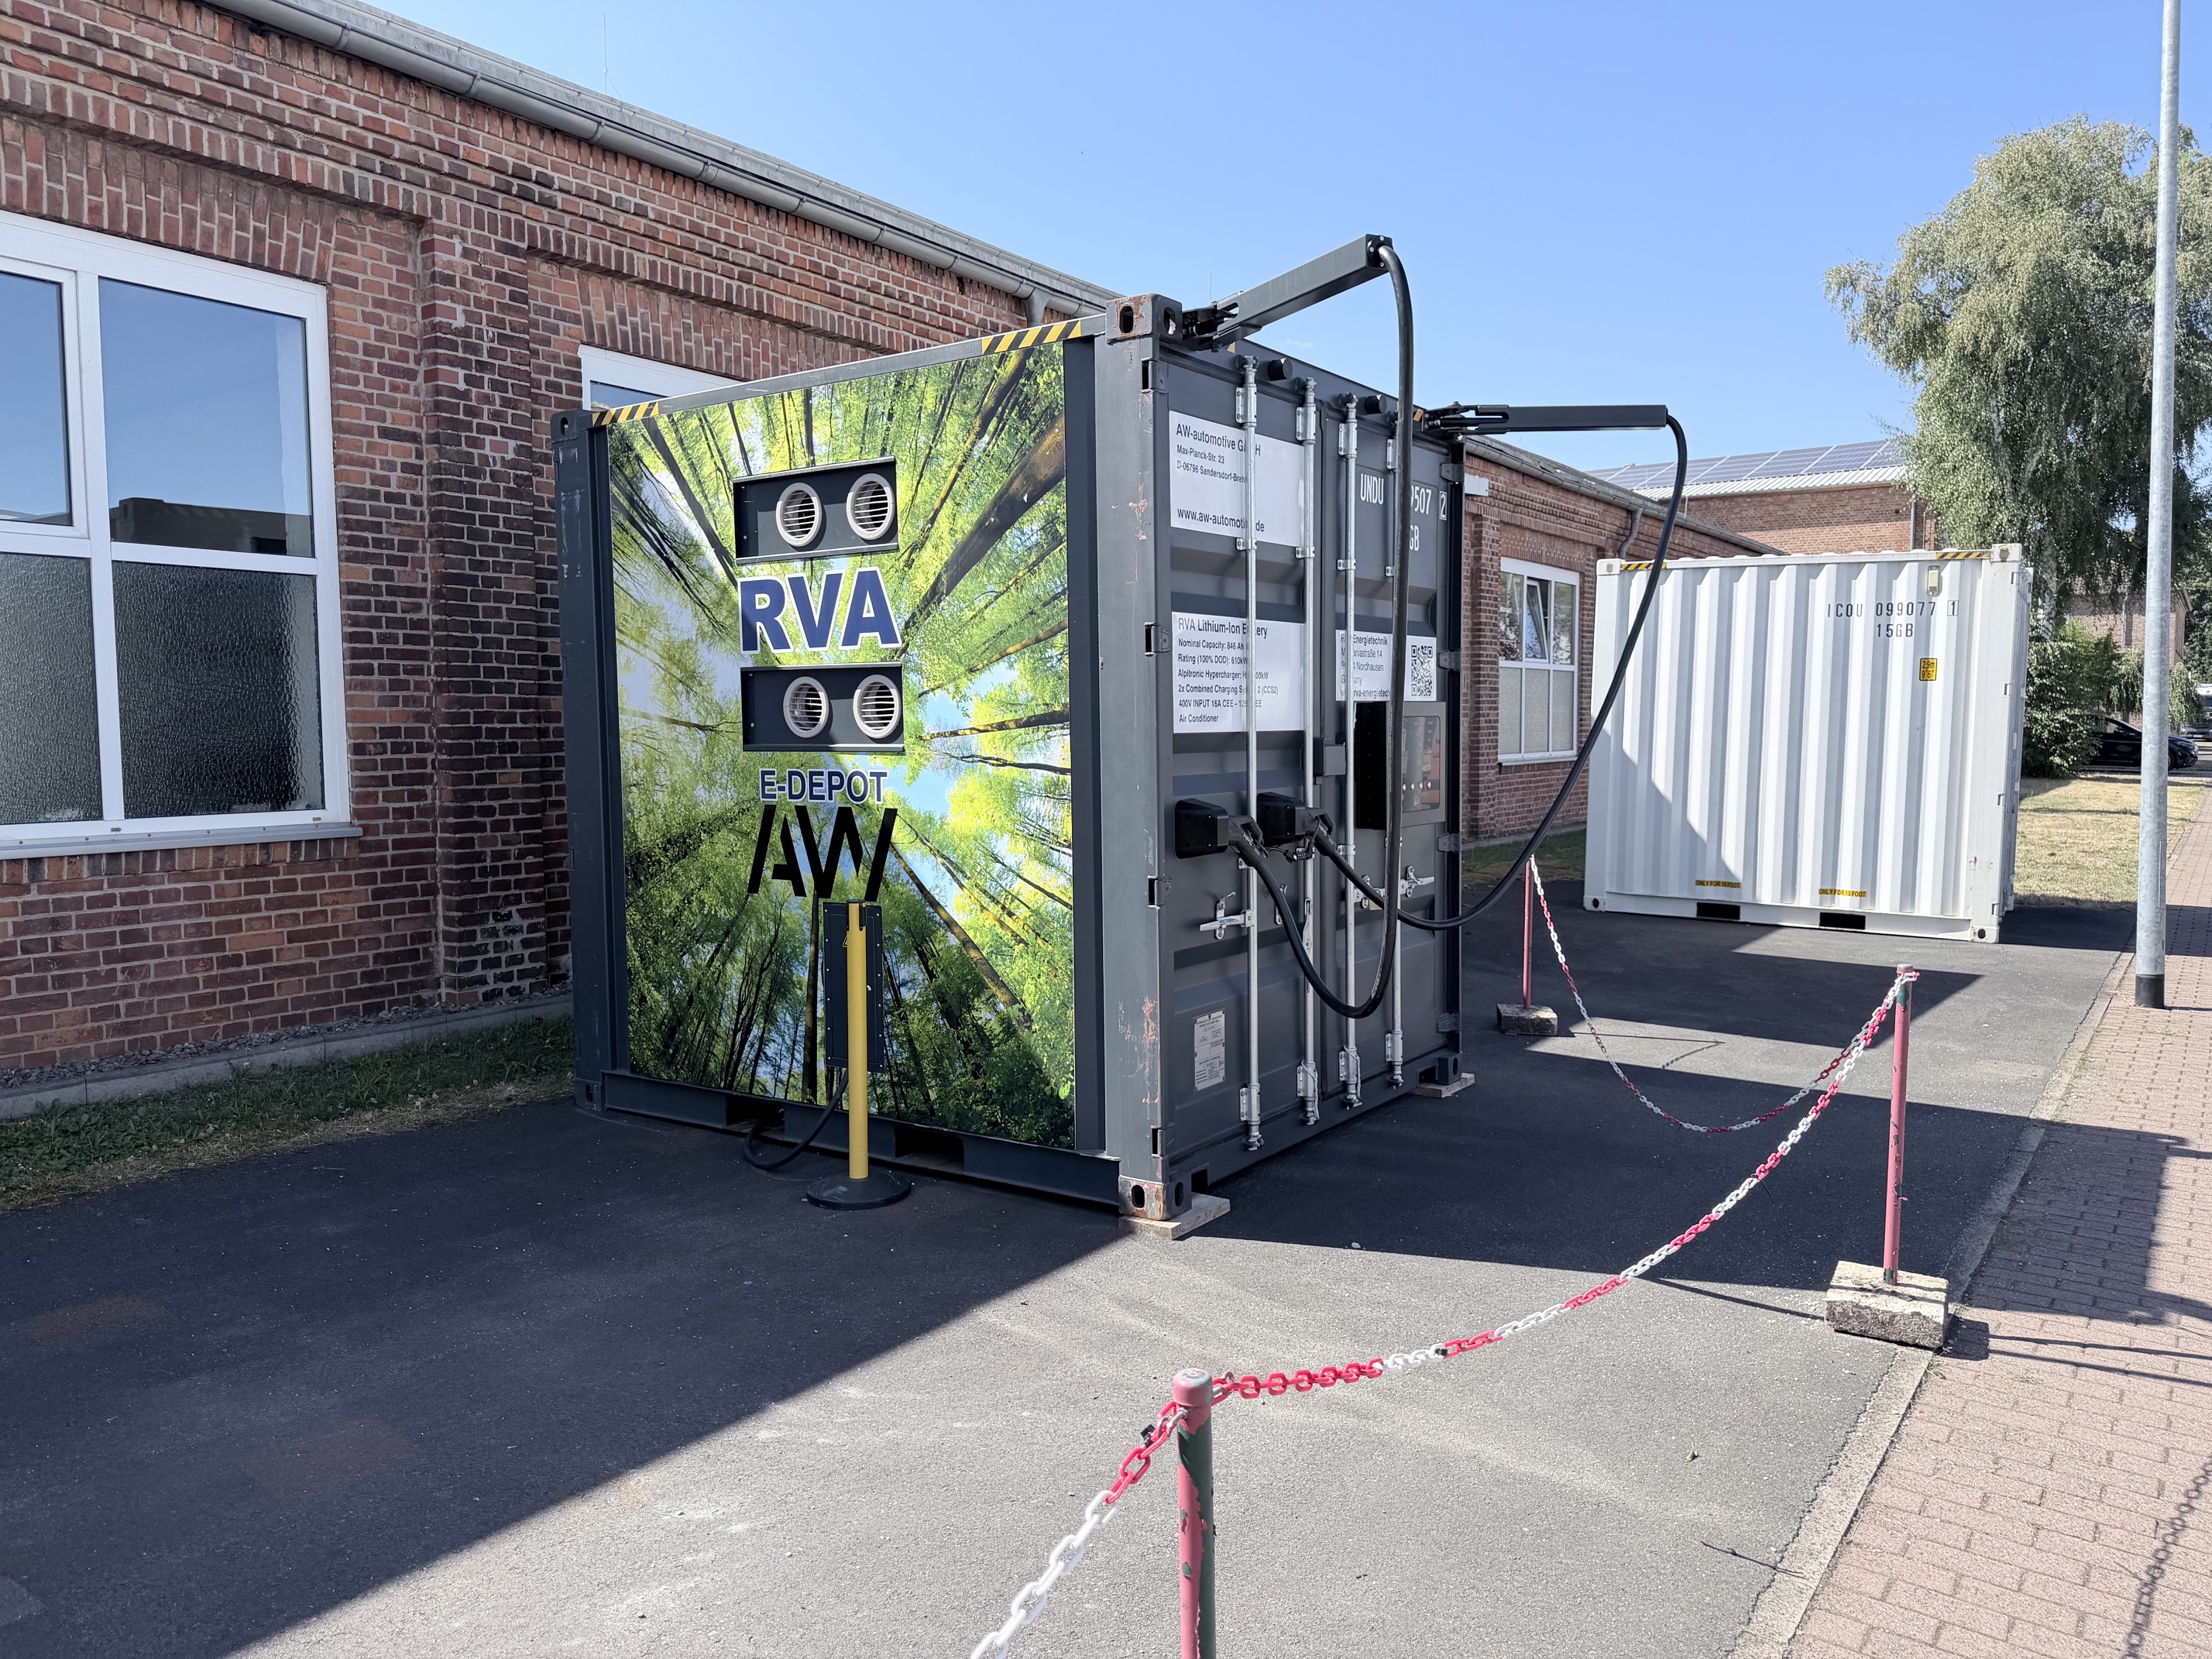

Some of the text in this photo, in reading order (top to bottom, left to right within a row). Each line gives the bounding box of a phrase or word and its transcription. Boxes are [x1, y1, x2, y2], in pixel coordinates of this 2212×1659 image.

[1176, 423, 1261, 456] AW-automotive GH
[1176, 444, 1224, 464] Max-Planck-Str. 23
[1176, 460, 1245, 483] D-06796 Sandersdorf-Breh
[1360, 472, 1384, 505] UNDU
[1440, 493, 1447, 519] 2
[1176, 508, 1265, 532] www.aw-automotide
[737, 565, 902, 654] RVA
[1827, 603, 1863, 618] ICOU
[1876, 601, 1936, 617] 099077
[1178, 617, 1268, 639] RVA Lithium-Ion Bery
[1877, 623, 1913, 637] 15GB
[1178, 638, 1201, 648] Nominal
[1201, 640, 1226, 651] Capacity:
[1227, 641, 1237, 650] 846
[1178, 654, 1196, 665] Rating
[1197, 654, 1214, 665] (100%
[1356, 661, 1384, 672] Nordhausen
[1178, 668, 1204, 678] Alpitronic
[1205, 670, 1242, 681] Hypercharger:
[1341, 674, 1362, 686] Gany
[1178, 684, 1185, 692] 2x
[1185, 684, 1214, 693] Combined
[1214, 685, 1238, 696] Charging
[1262, 685, 1279, 696] (CCS2)
[1178, 699, 1192, 708] 400V
[1193, 699, 1210, 708] INPUT
[1211, 699, 1221, 708] 16A
[1222, 699, 1234, 708] CEE
[1179, 714, 1219, 723] Air Conditioner
[759, 768, 889, 805] E-DEPOT
[747, 804, 898, 902] AW
